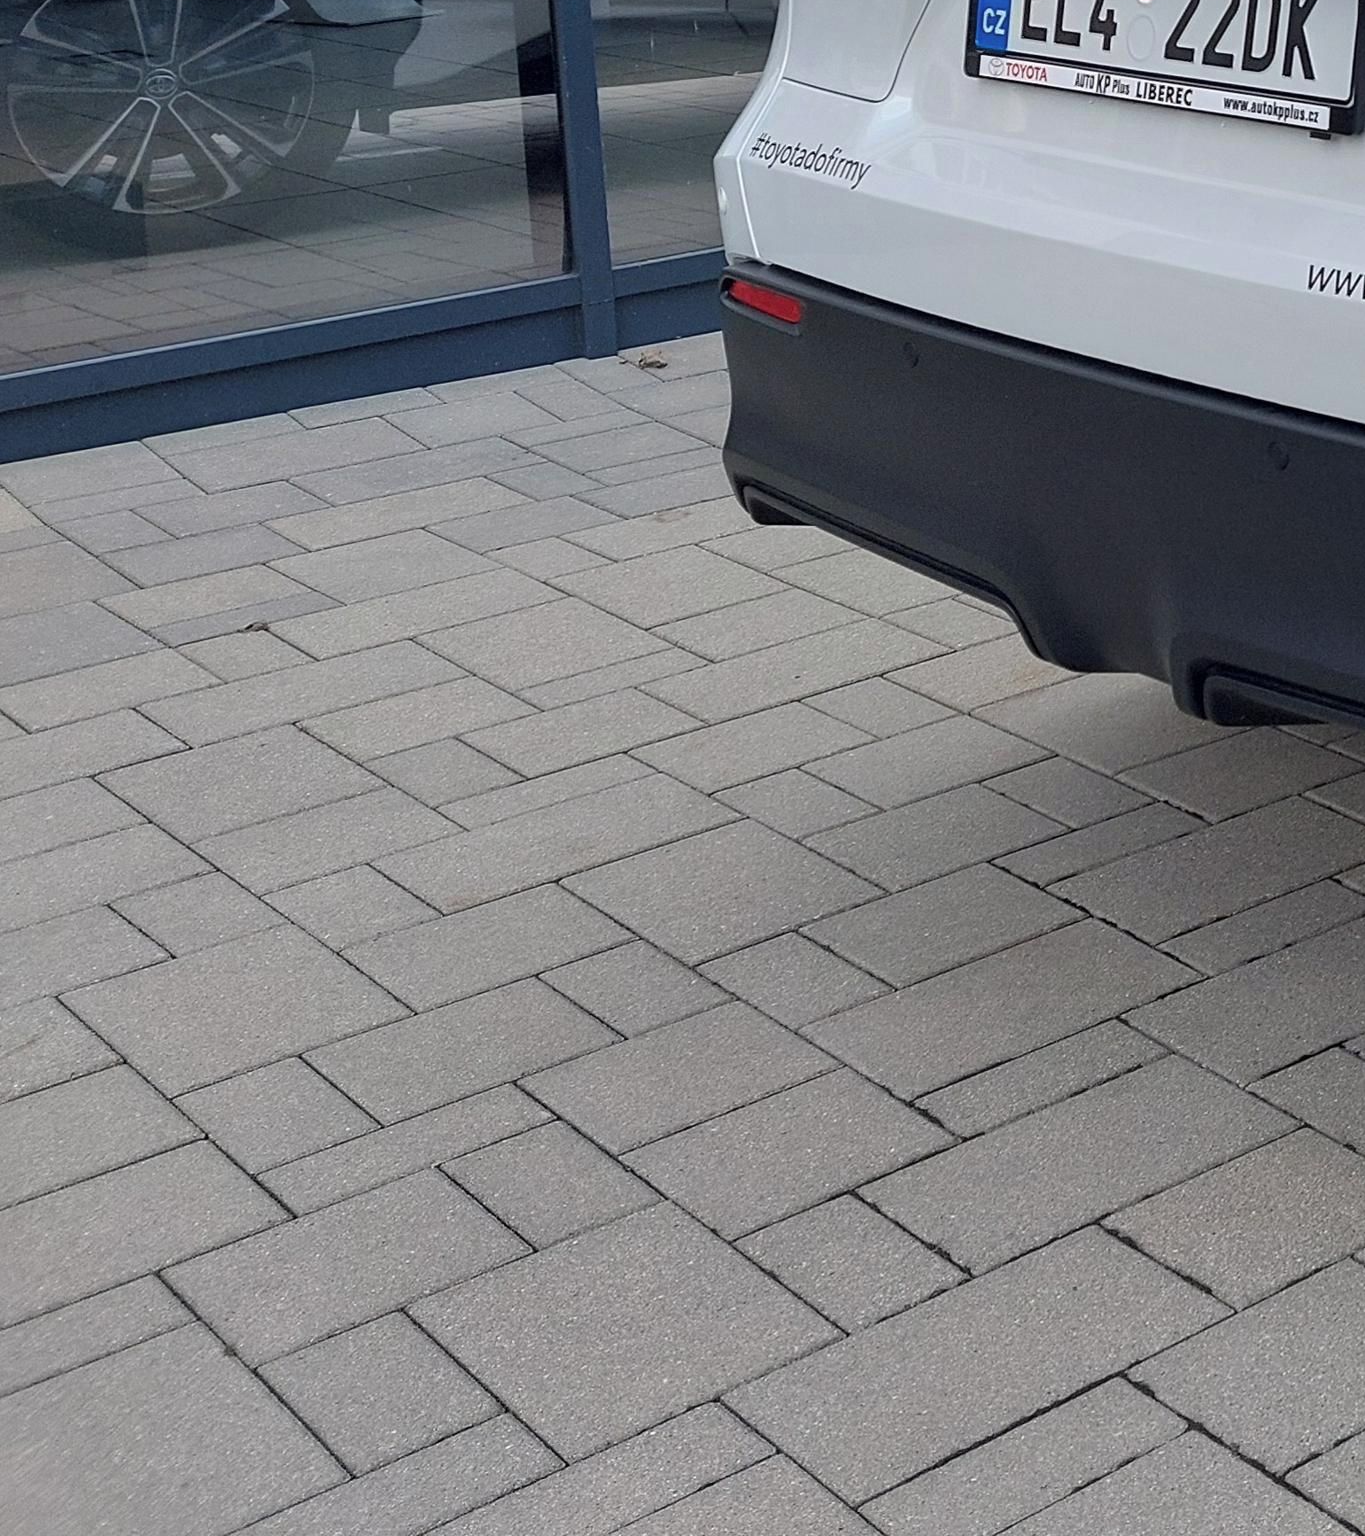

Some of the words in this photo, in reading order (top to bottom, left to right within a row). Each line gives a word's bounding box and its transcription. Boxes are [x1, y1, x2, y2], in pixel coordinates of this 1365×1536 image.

[982, 8, 1007, 36] CZ
[1005, 62, 1047, 83] TOYOTA
[1074, 72, 1095, 90] AUTO
[1095, 73, 1111, 94] KP
[1112, 78, 1130, 95] Plus
[1135, 82, 1193, 107] LIBEREC
[1223, 95, 1319, 124] www.autokpplus.cz
[749, 132, 872, 190] #toyotadofirmy
